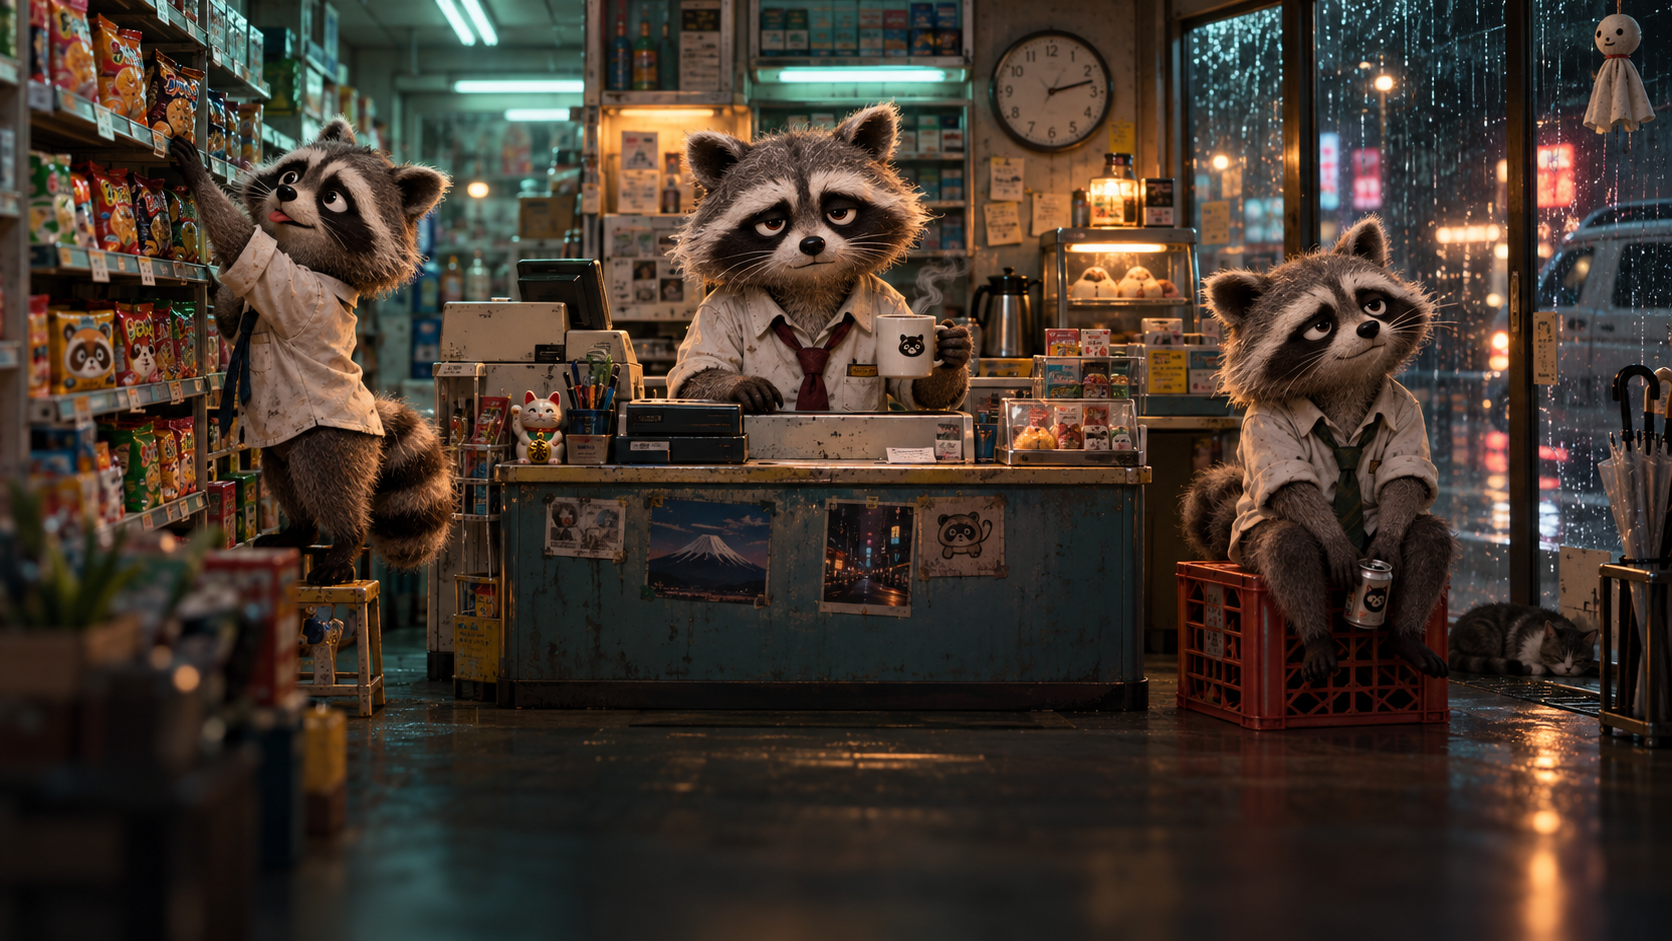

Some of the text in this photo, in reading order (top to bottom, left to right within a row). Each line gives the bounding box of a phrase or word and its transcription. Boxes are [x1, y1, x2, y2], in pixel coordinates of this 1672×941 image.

[1026, 51, 1036, 62] 11
[1046, 45, 1059, 57] 12
[1011, 65, 1024, 77] 10
[1084, 65, 1092, 77] 2
[1005, 86, 1013, 98] 9
[1090, 86, 1098, 98] 3
[1011, 107, 1020, 119] 8
[1084, 107, 1092, 118] 4
[1028, 122, 1036, 132] 7
[1048, 127, 1056, 139] 6
[1069, 121, 1077, 133] 5
